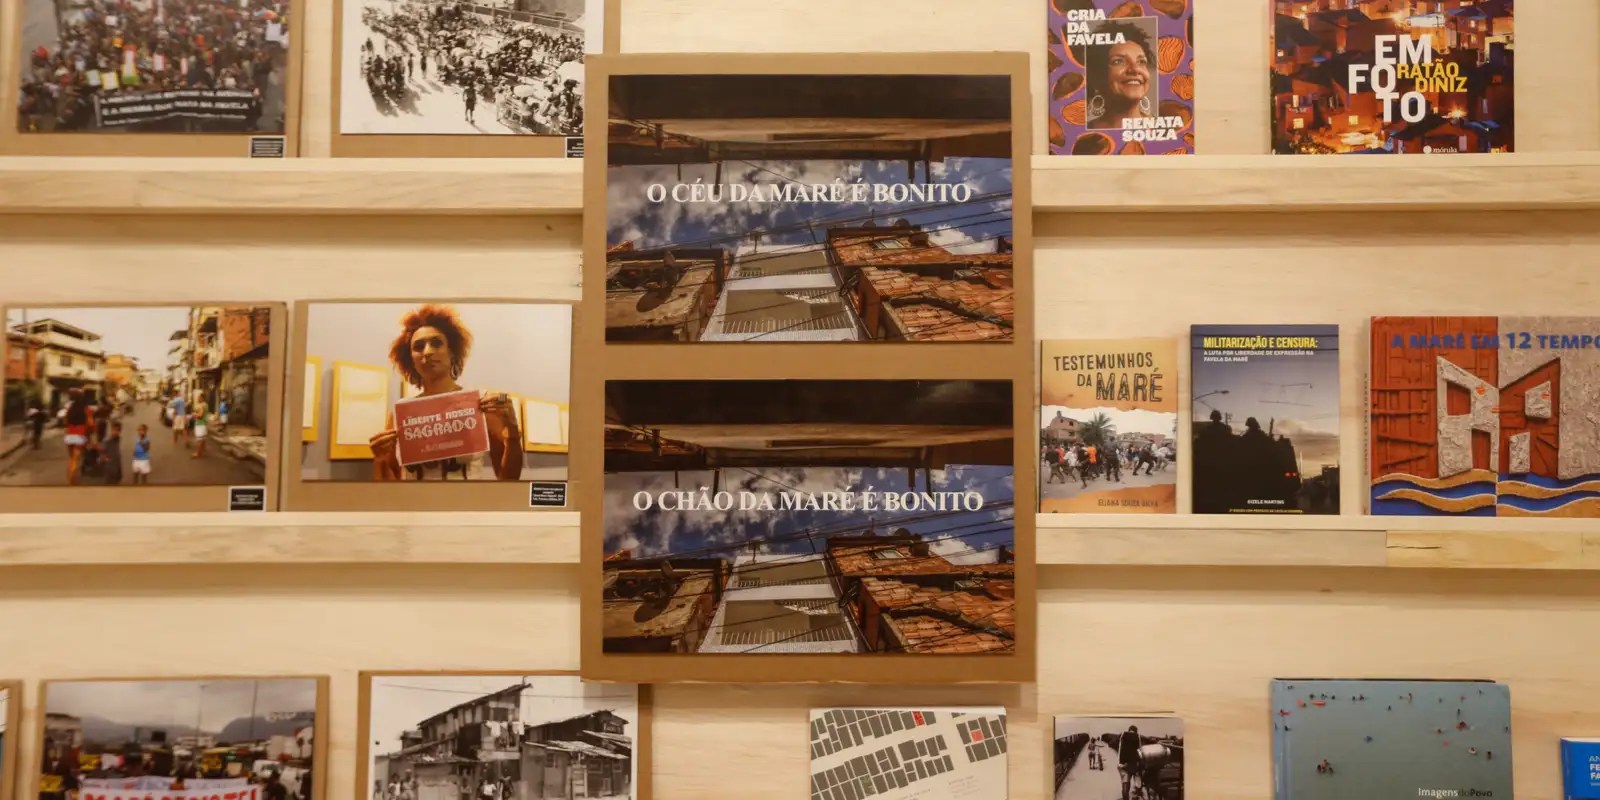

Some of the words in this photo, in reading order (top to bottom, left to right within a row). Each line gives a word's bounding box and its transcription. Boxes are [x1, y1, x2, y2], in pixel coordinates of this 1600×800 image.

[1067, 9, 1106, 21] CRIA
[1067, 21, 1090, 34] DA
[1067, 32, 1126, 46] FAVELA
[1374, 34, 1433, 64] EM
[1396, 58, 1460, 79] RATÃO
[1347, 63, 1397, 95] FO
[1415, 77, 1468, 93] DINIZ
[1375, 91, 1426, 123] TO
[1122, 116, 1184, 130] RENATA
[1122, 129, 1178, 142] SOUZA
[647, 183, 667, 203] O
[671, 178, 724, 203] CÉU
[729, 183, 765, 203] DA
[769, 178, 845, 203] MARÉ
[850, 177, 868, 203] É
[873, 183, 971, 203] BONITO
[1203, 336, 1267, 350] MILITARIZAÇÃO
[1269, 337, 1275, 348] E
[1276, 337, 1318, 348] CENSURA:
[1391, 333, 1404, 349] A
[1409, 331, 1465, 349] MARÉ
[1471, 335, 1500, 349] EM
[1505, 332, 1533, 349] 12
[1053, 352, 1154, 371] TESTEMUNHOS
[1077, 373, 1093, 387] DA
[1096, 367, 1163, 403] MARÉ
[403, 416, 477, 441] SAGRADO
[633, 491, 653, 511] O
[657, 486, 734, 511] CHÃO
[739, 491, 775, 511] DA
[780, 486, 856, 511] MARÉ
[862, 486, 879, 511] É
[885, 491, 984, 511] BONITO
